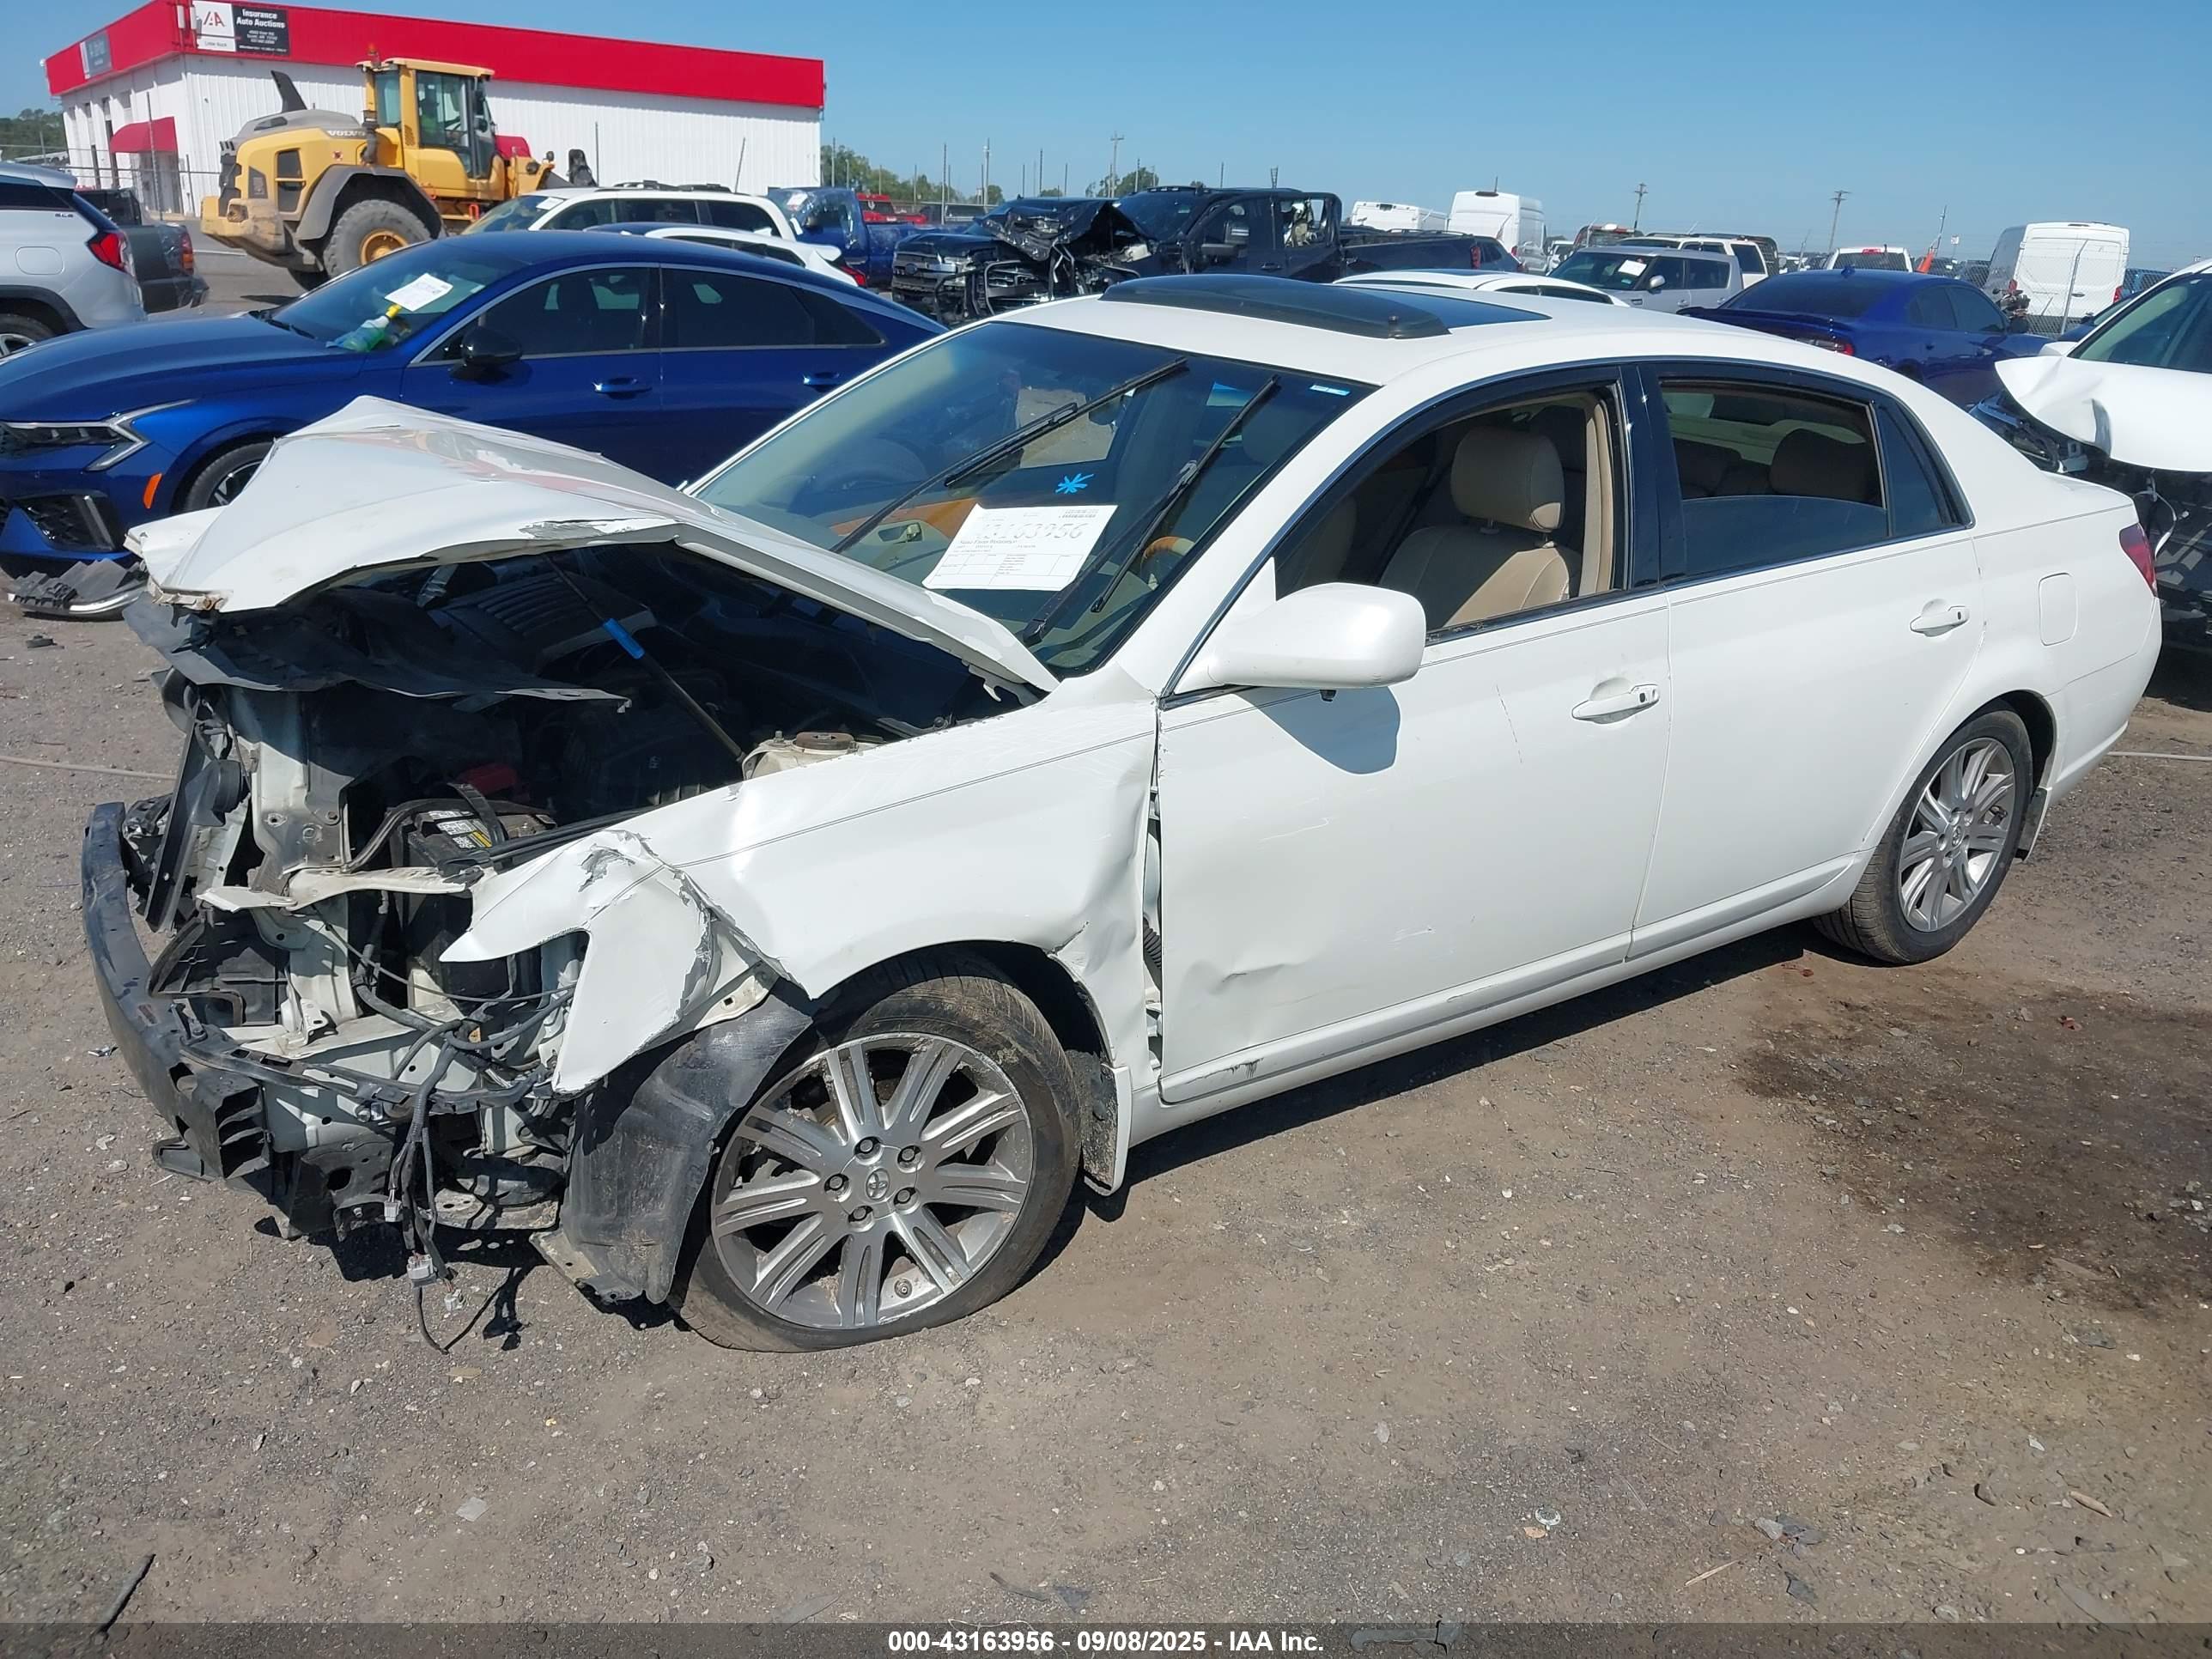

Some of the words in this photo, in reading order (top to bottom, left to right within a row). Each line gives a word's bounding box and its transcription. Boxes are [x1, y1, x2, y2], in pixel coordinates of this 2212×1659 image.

[242, 9, 277, 20] Insurance
[236, 16, 253, 26] Auto
[254, 18, 285, 28] Auctions
[975, 522, 1089, 539] 3163956
